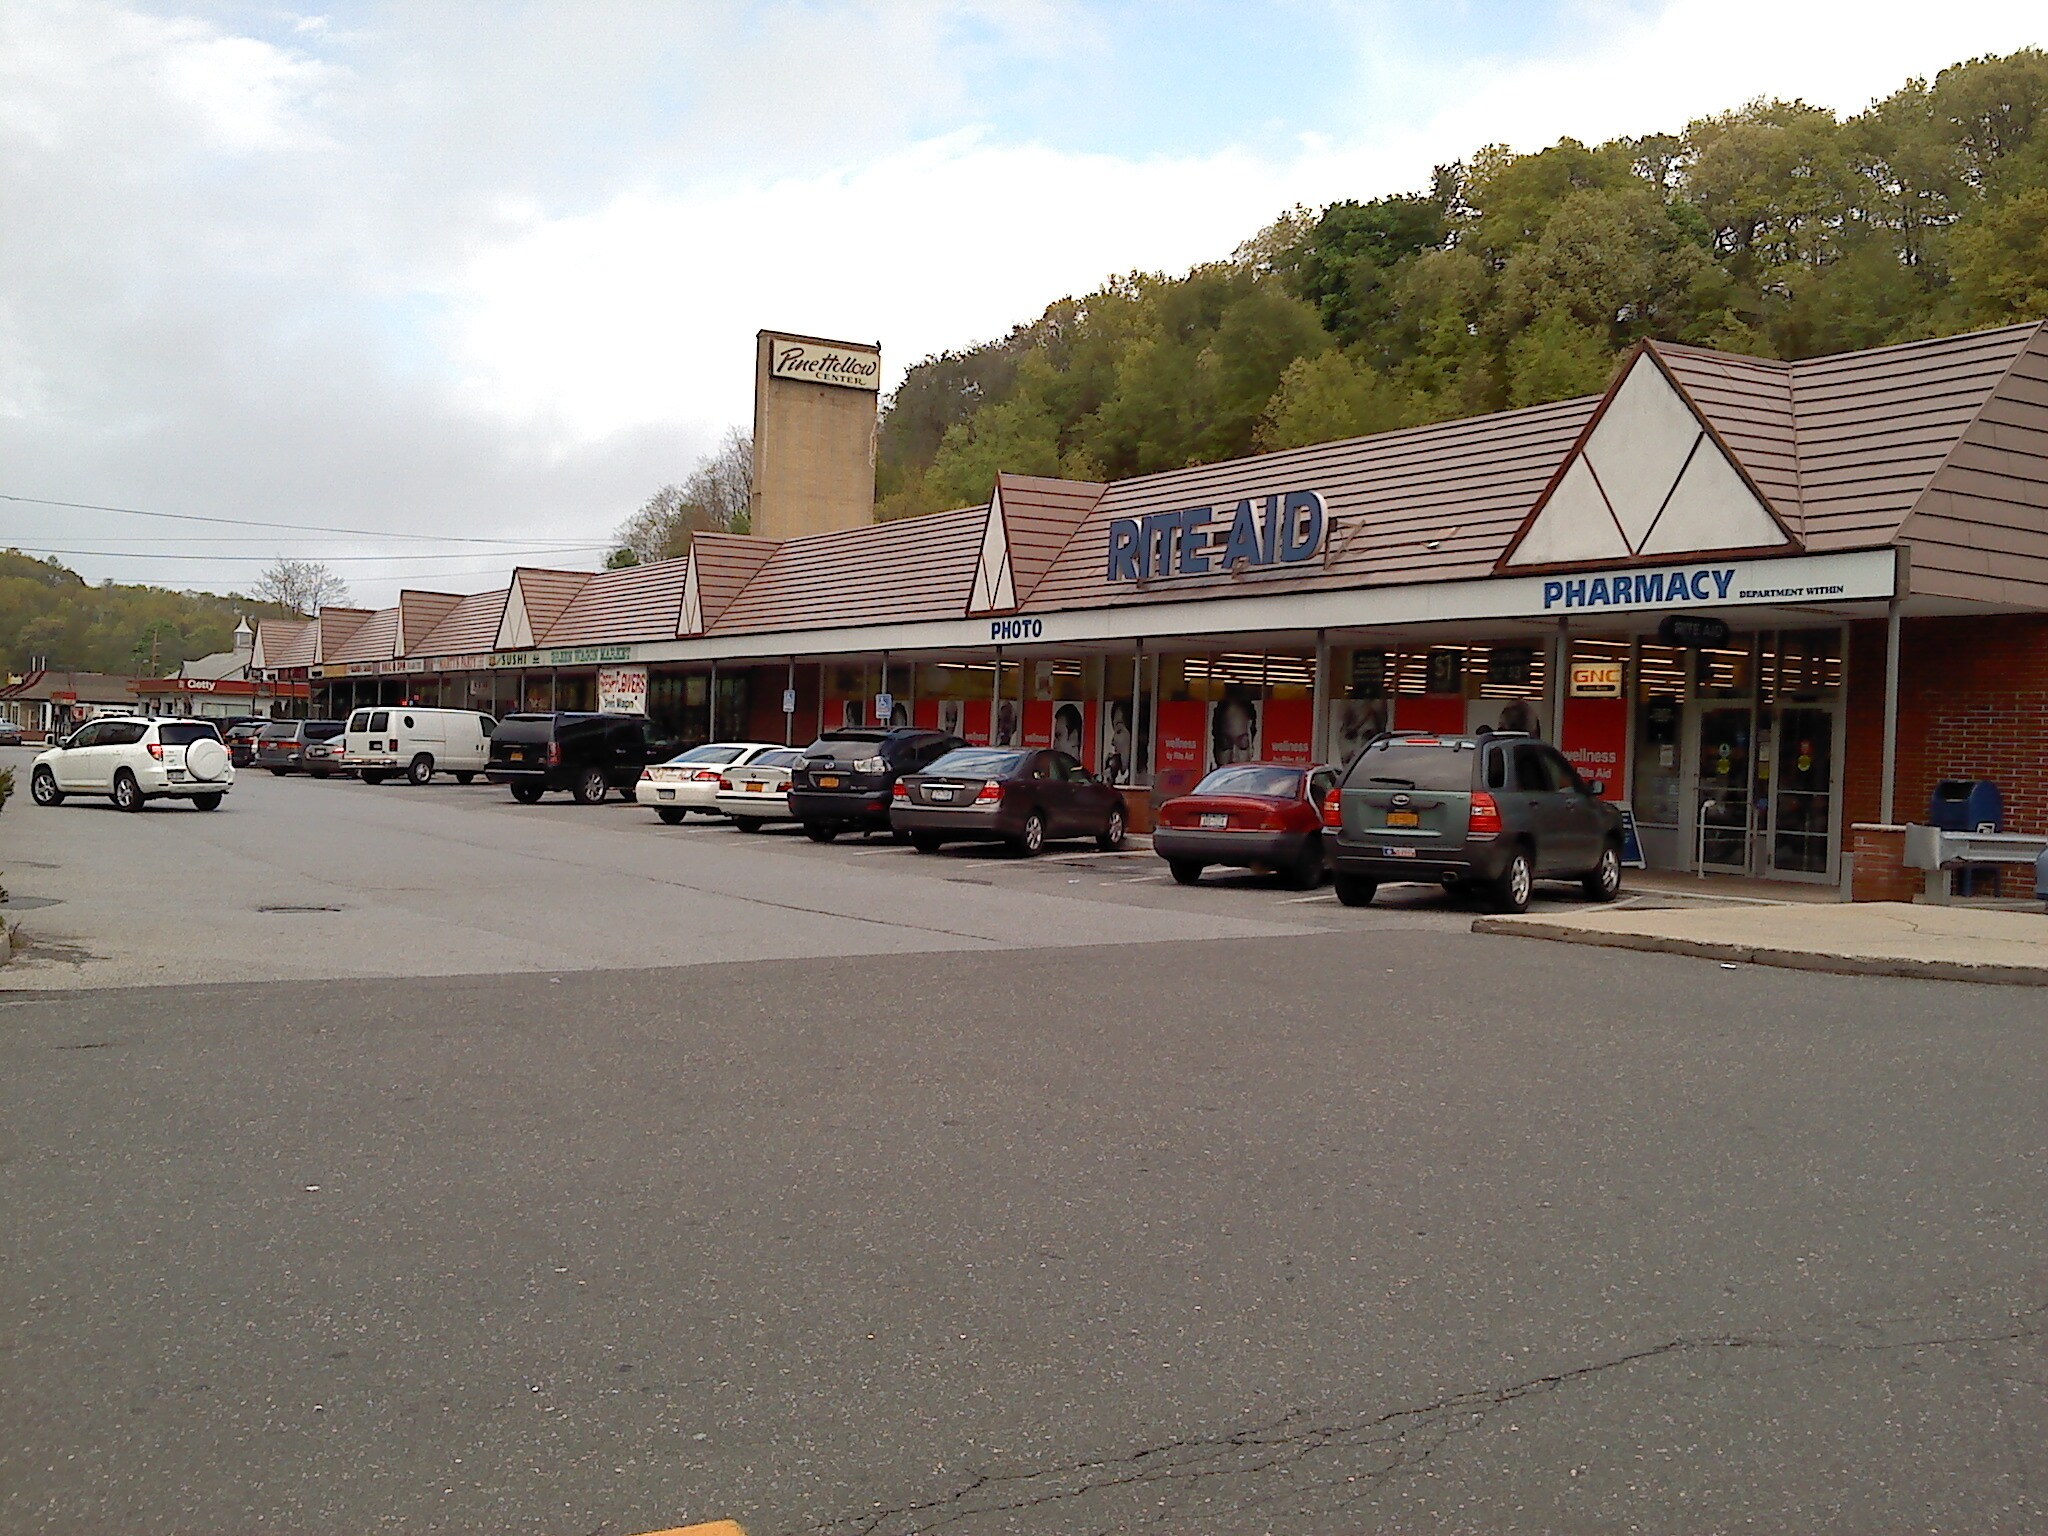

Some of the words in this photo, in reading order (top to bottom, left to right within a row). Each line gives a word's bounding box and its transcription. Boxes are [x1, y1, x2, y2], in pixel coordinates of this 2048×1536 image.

[777, 347, 817, 373] Pine
[818, 353, 877, 376] Hollow
[815, 372, 867, 386] CENTER
[1107, 507, 1217, 582] RITE
[1222, 489, 1329, 570] AID
[1543, 568, 1736, 610] PHARMACY
[1739, 587, 1804, 599] DEPARTMENT
[1805, 585, 1844, 597] WITHIN
[991, 619, 1043, 640] PHOTO
[501, 654, 527, 665] SUSHI
[600, 647, 632, 661] MARKET
[1573, 669, 1620, 683] GNC
[187, 679, 216, 691] Getty
[1165, 738, 1197, 750] wellness
[1272, 740, 1309, 752] wellness
[1185, 752, 1195, 760] Aid
[1562, 748, 1616, 763] wellness
[1595, 767, 1612, 778] Aid
